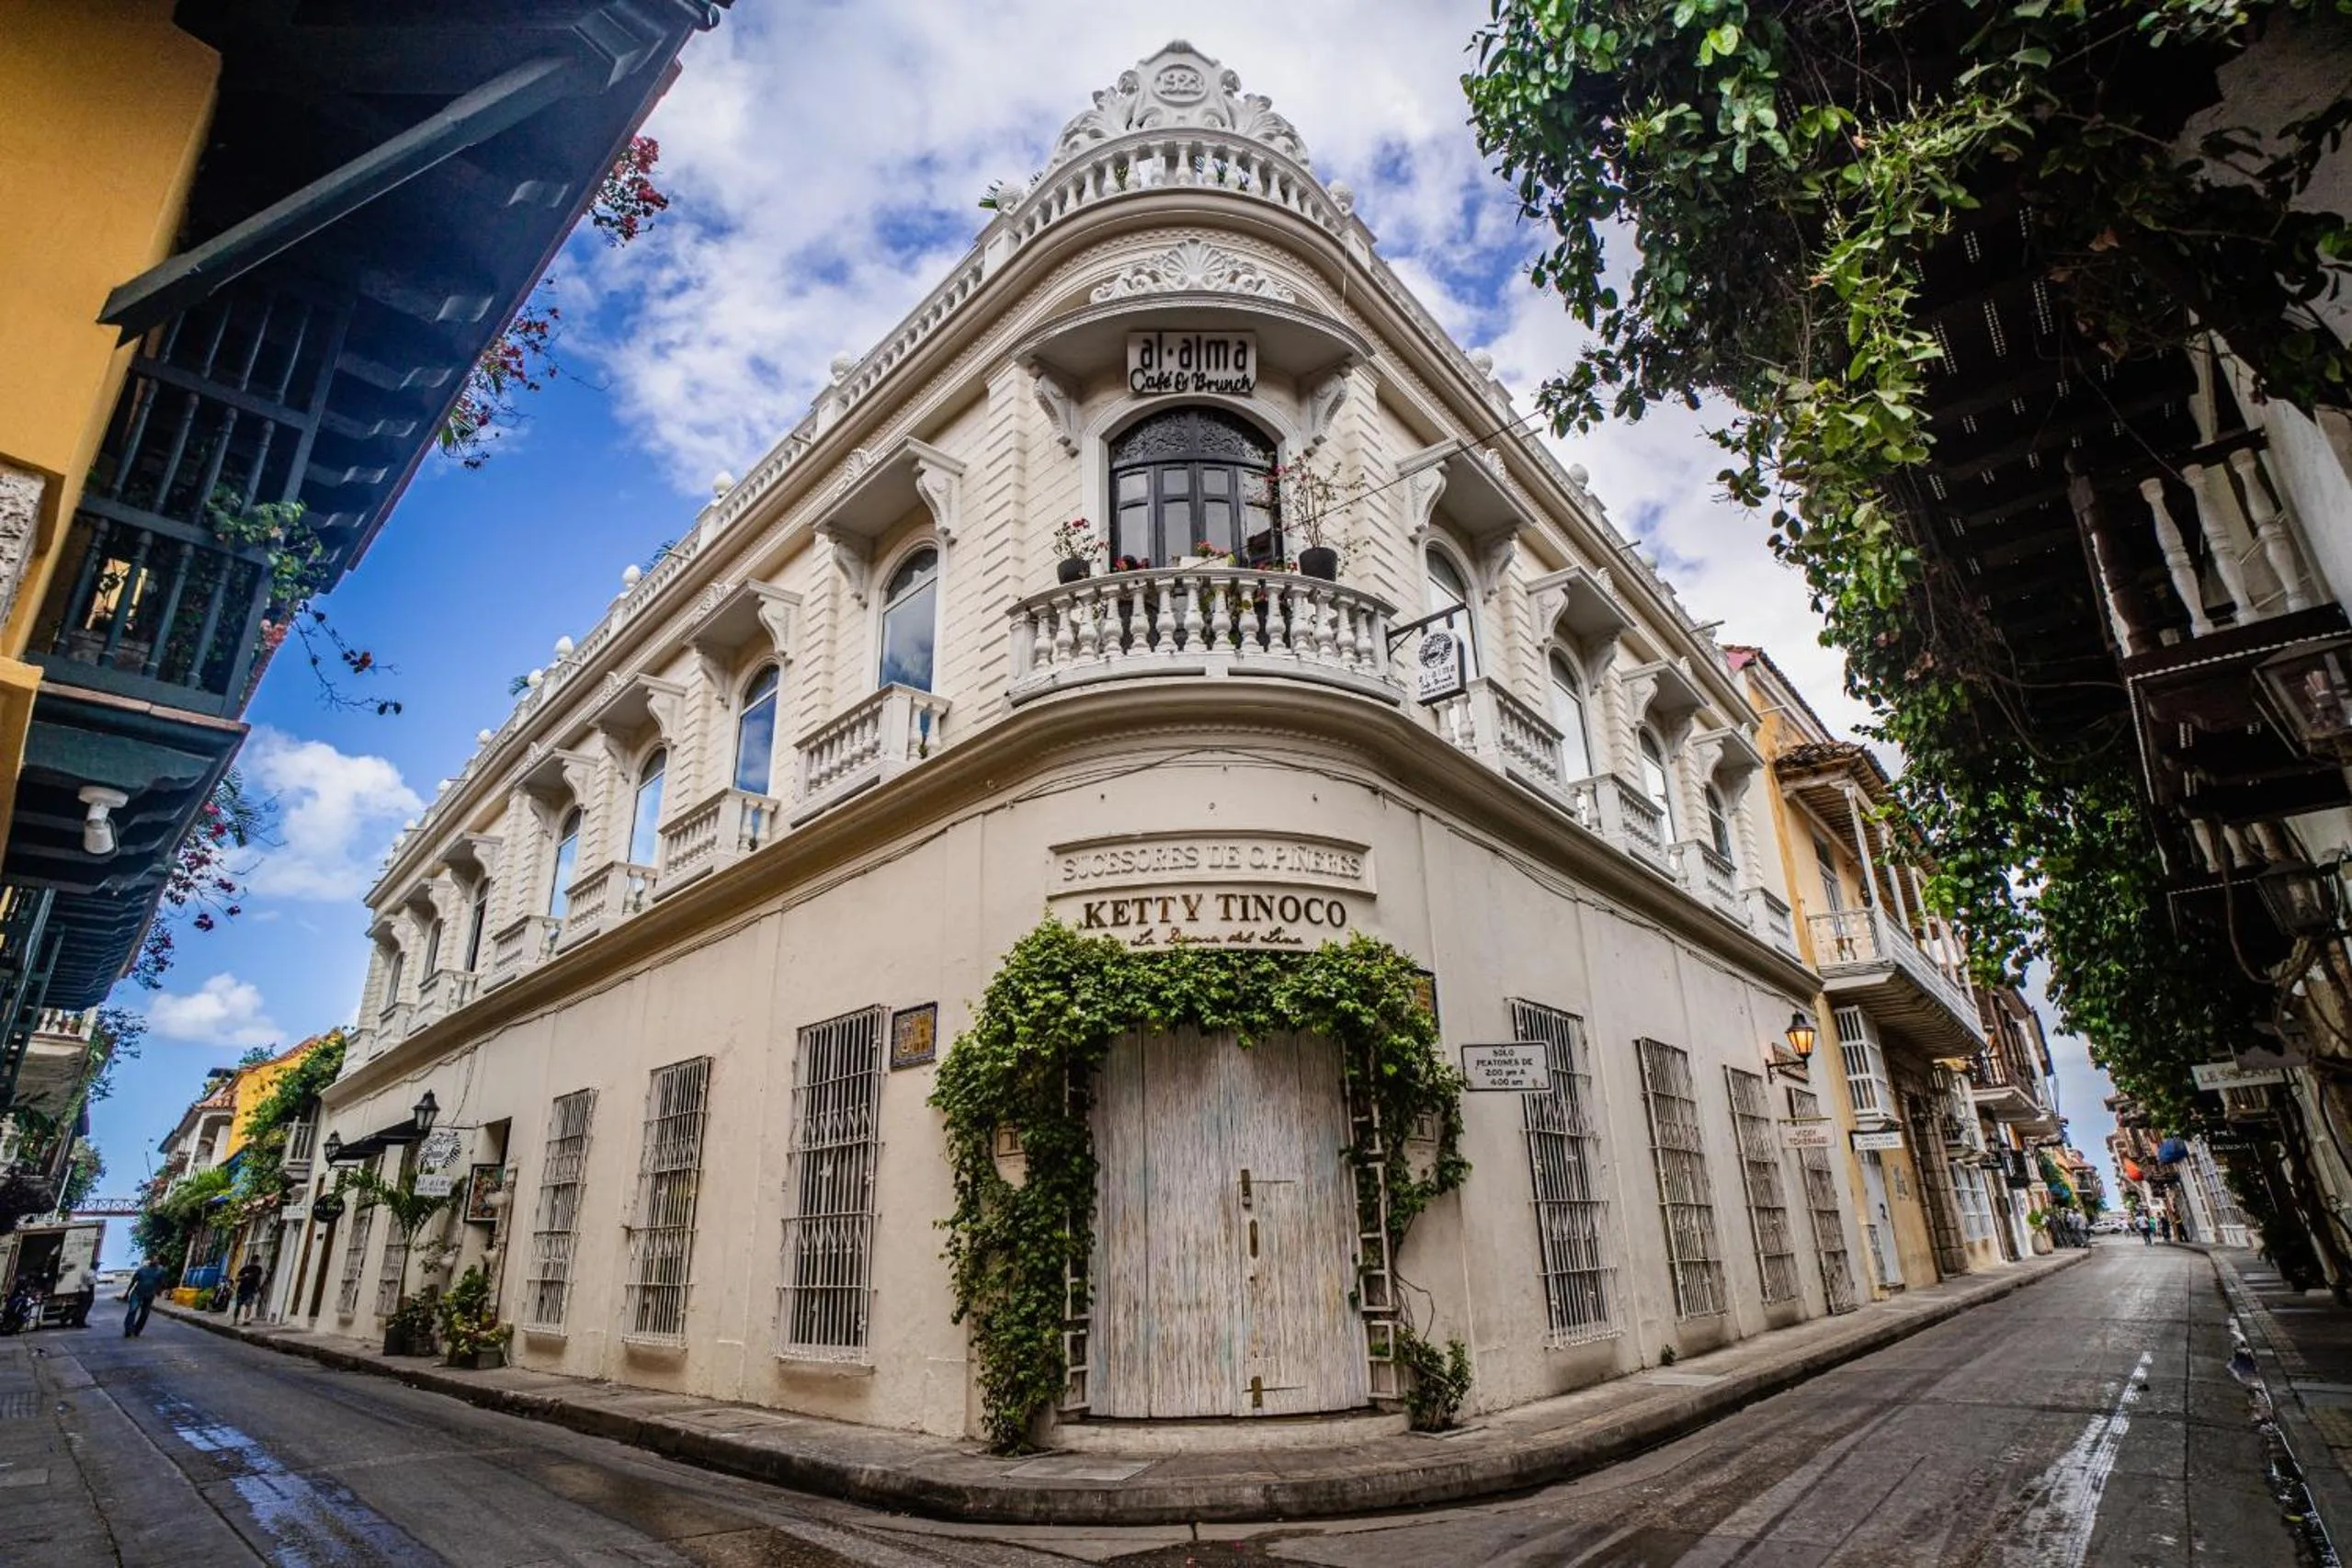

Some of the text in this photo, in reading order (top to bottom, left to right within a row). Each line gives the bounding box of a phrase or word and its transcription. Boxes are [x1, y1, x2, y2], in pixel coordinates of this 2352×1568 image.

[1130, 368, 1256, 392] Café & Brunch
[1062, 846, 1199, 881] SUCESORES
[1207, 846, 1241, 869] DE
[1084, 893, 1346, 929] KETTY TINOCO
[1131, 928, 1156, 946] La
[1477, 1058, 1520, 1067] PEATONES
